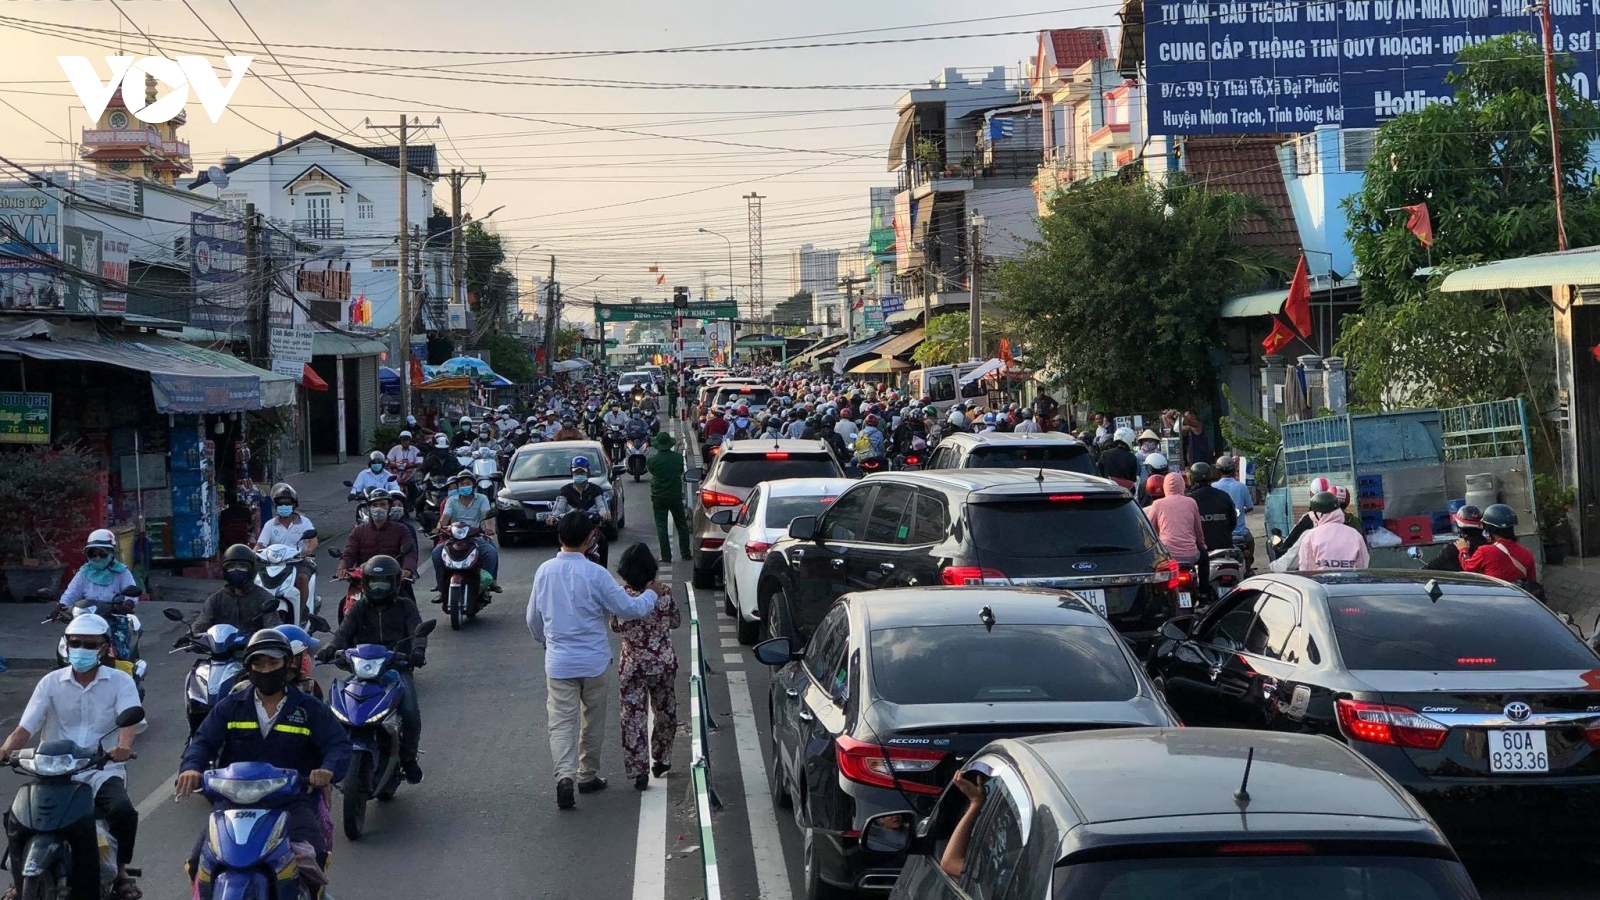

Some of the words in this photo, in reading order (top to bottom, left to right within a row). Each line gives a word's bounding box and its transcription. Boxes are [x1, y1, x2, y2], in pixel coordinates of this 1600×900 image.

[1159, 42, 1205, 61] CUNG
[1211, 34, 1244, 60] CẤP
[1248, 36, 1305, 59] THÔNG
[1310, 38, 1337, 57] TIN
[1343, 38, 1374, 59] QUY
[1380, 36, 1432, 59] HOẠCH
[1569, 30, 1590, 51] SƠ
[1161, 81, 1186, 98] Đ/c:
[1188, 82, 1203, 96] 99
[1207, 80, 1219, 99] Lý
[1223, 79, 1248, 96] Thái
[1284, 78, 1302, 99] Đại
[1305, 77, 1339, 94] Phước
[1163, 109, 1197, 128] Huyện
[1200, 108, 1228, 125] Nhơn
[1230, 107, 1265, 127] Trạch,
[1295, 104, 1323, 123] Đồng
[1327, 104, 1344, 121] Nai
[1200, 514, 1226, 522] ADES
[1503, 734, 1533, 750] 60A
[1493, 752, 1546, 770] 833.36
